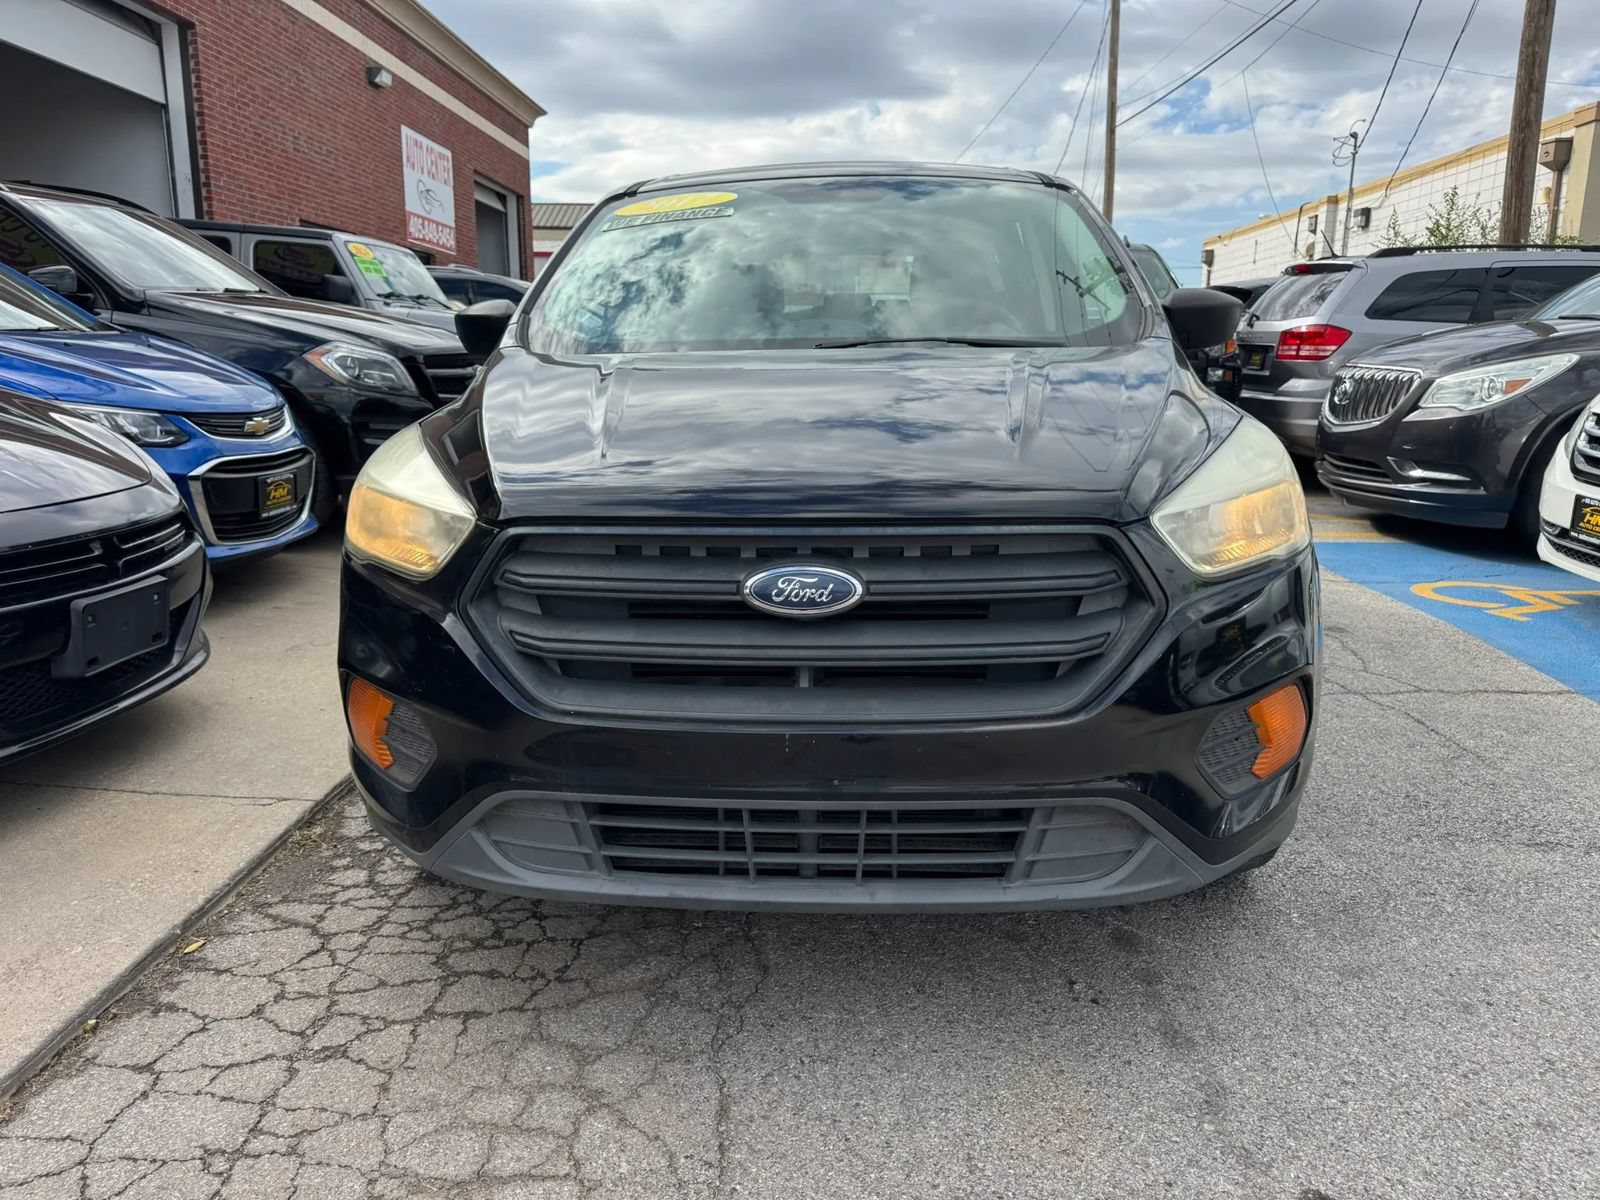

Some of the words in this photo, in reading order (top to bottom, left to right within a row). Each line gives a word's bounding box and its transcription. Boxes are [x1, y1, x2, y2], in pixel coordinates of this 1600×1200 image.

[405, 132, 426, 176] AUTO
[426, 143, 453, 187] CENTER
[640, 206, 729, 225] FINANCE
[771, 576, 834, 602] Ford
